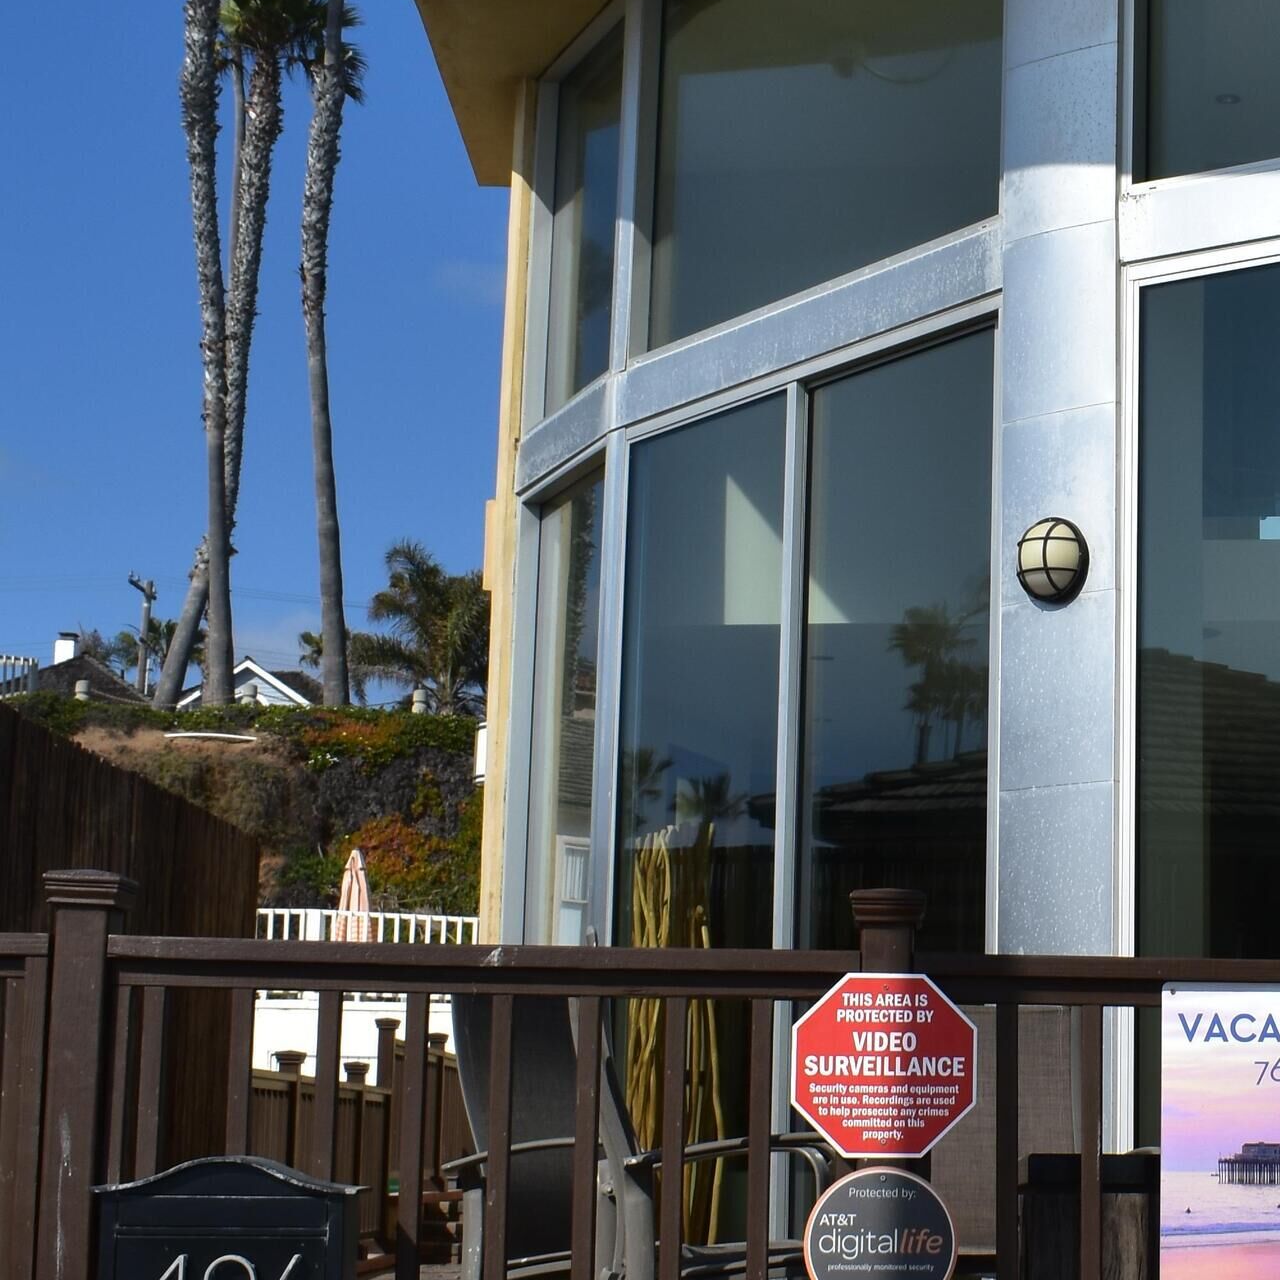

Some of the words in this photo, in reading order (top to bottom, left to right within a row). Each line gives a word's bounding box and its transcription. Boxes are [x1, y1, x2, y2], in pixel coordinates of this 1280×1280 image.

[842, 993, 872, 1006] THIS
[875, 993, 911, 1006] AREA
[915, 994, 928, 1006] IS
[836, 1010, 913, 1023] PROTECTED
[916, 1010, 934, 1023] BY
[852, 1031, 917, 1052] VIDEO
[804, 1055, 966, 1076] SURVEILLANCE
[809, 1083, 847, 1095] Security
[849, 1084, 889, 1094] cameras
[890, 1084, 908, 1094] and
[910, 1084, 959, 1095] equipment
[812, 1096, 829, 1105] are
[830, 1095, 839, 1105] in
[840, 1096, 860, 1105] use.
[862, 1095, 914, 1107] Recordings
[915, 1096, 931, 1105] are
[933, 1095, 956, 1105] used
[818, 1106, 828, 1116] to
[830, 1106, 850, 1118] help
[851, 1106, 899, 1118] prosecute
[900, 1108, 916, 1118] any
[918, 1107, 949, 1116] crimes
[842, 1118, 892, 1128] committed
[893, 1119, 905, 1128] on
[907, 1118, 925, 1128] this
[862, 1130, 904, 1141] property.
[848, 1187, 898, 1198] Protected
[901, 1187, 916, 1200] by:
[819, 1213, 857, 1226] AT&T
[827, 1263, 872, 1272] professionally
[873, 1263, 907, 1271] monitored
[908, 1263, 935, 1272] security
